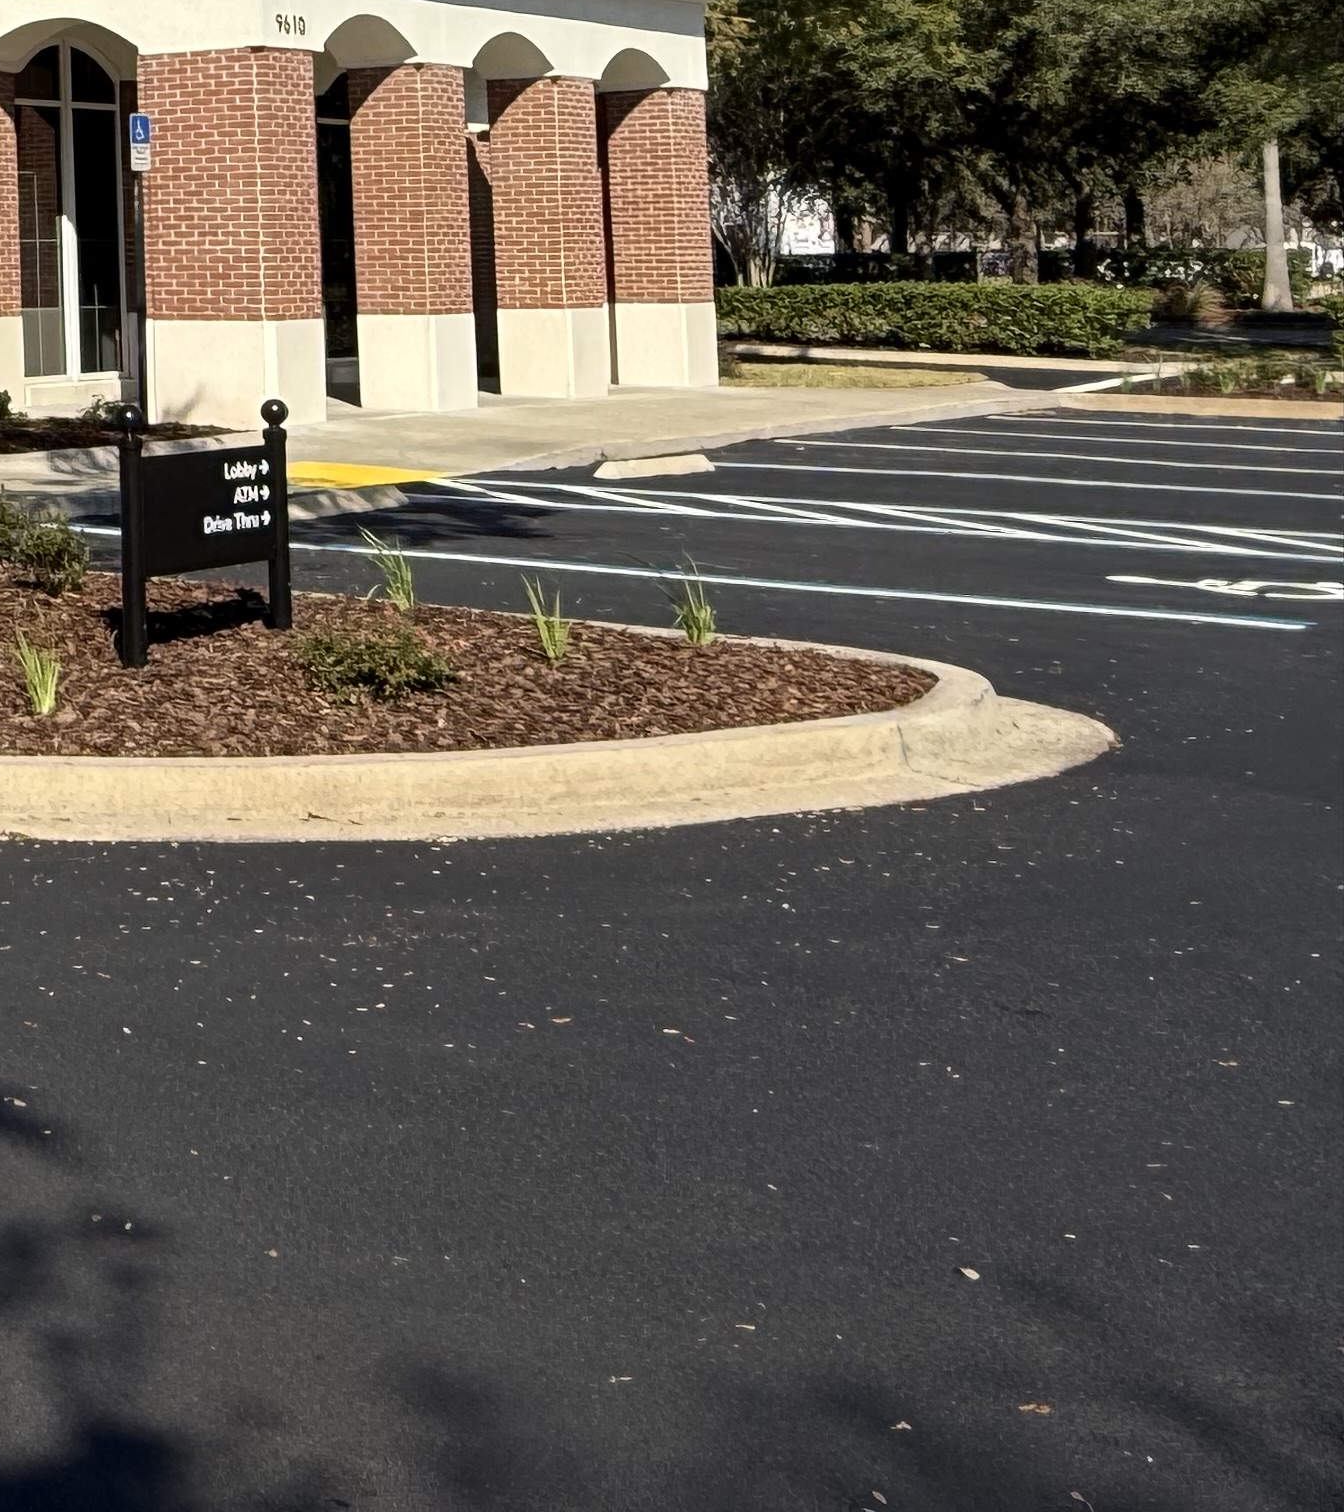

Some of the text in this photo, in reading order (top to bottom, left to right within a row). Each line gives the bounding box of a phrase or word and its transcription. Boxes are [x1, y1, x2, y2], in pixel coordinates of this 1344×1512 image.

[223, 460, 258, 481] Lobby
[233, 485, 259, 504] ATM
[203, 511, 260, 534] Drive Thru
